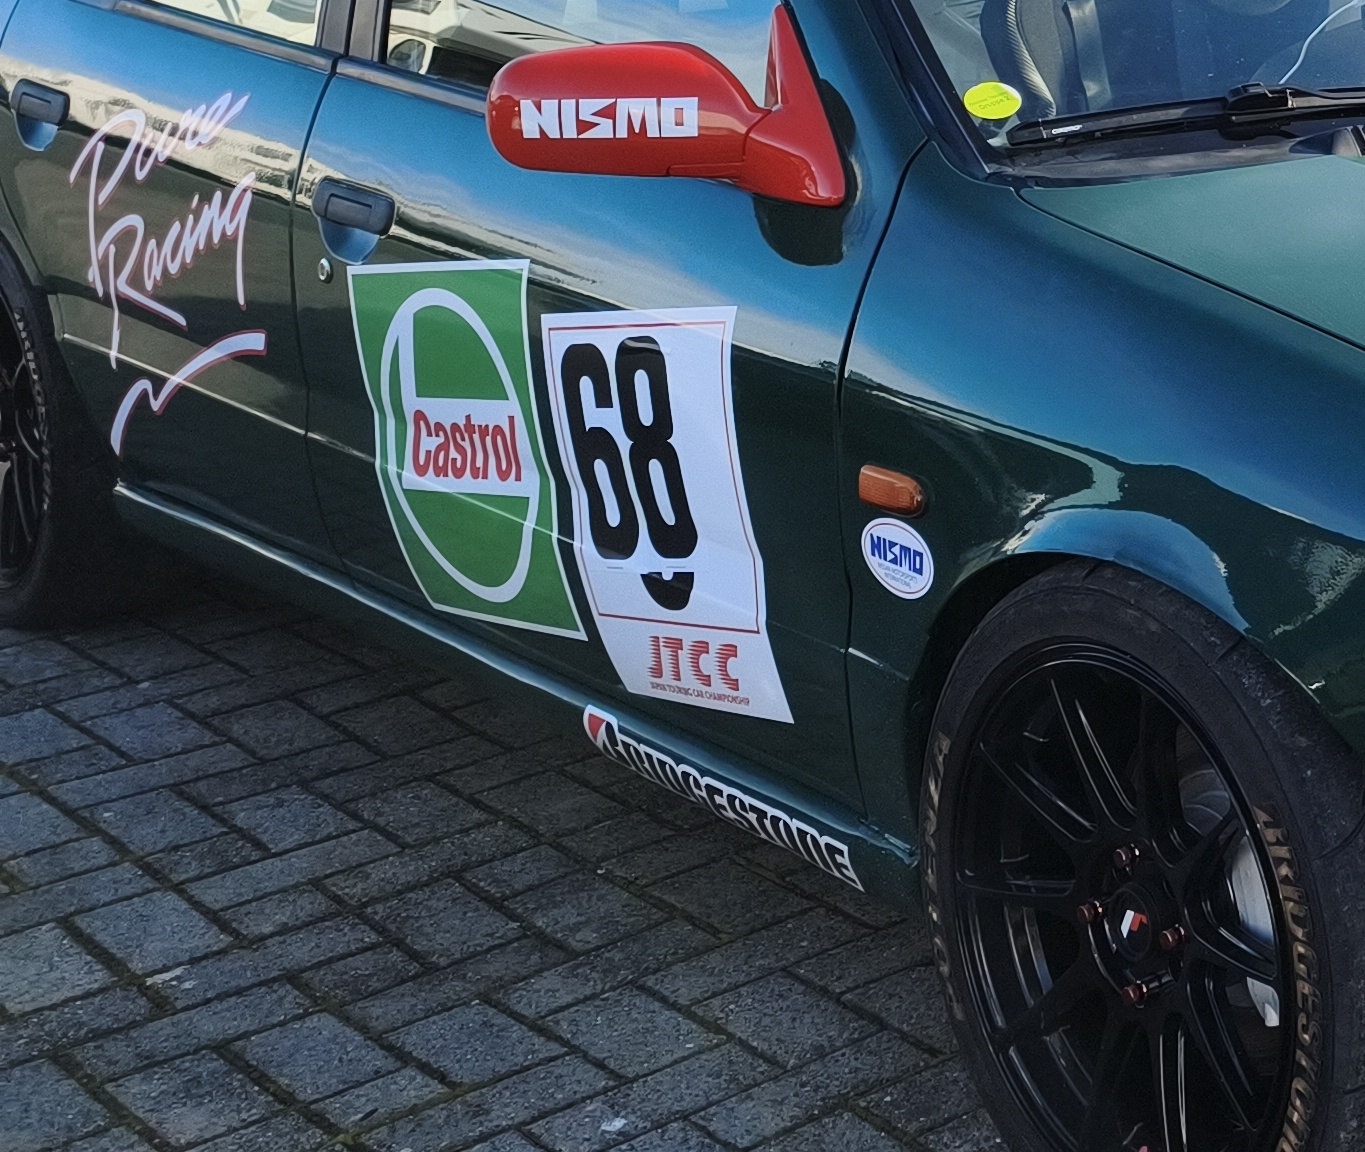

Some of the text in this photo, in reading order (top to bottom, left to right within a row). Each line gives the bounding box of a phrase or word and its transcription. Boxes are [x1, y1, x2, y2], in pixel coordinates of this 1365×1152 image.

[520, 96, 699, 140] NISMO
[88, 171, 256, 371] Racing
[412, 409, 524, 484] Castrol
[560, 334, 700, 560] 68
[869, 532, 924, 577] NISMO
[646, 635, 740, 692] JTCC
[587, 706, 861, 887] BRIDGESTONE
